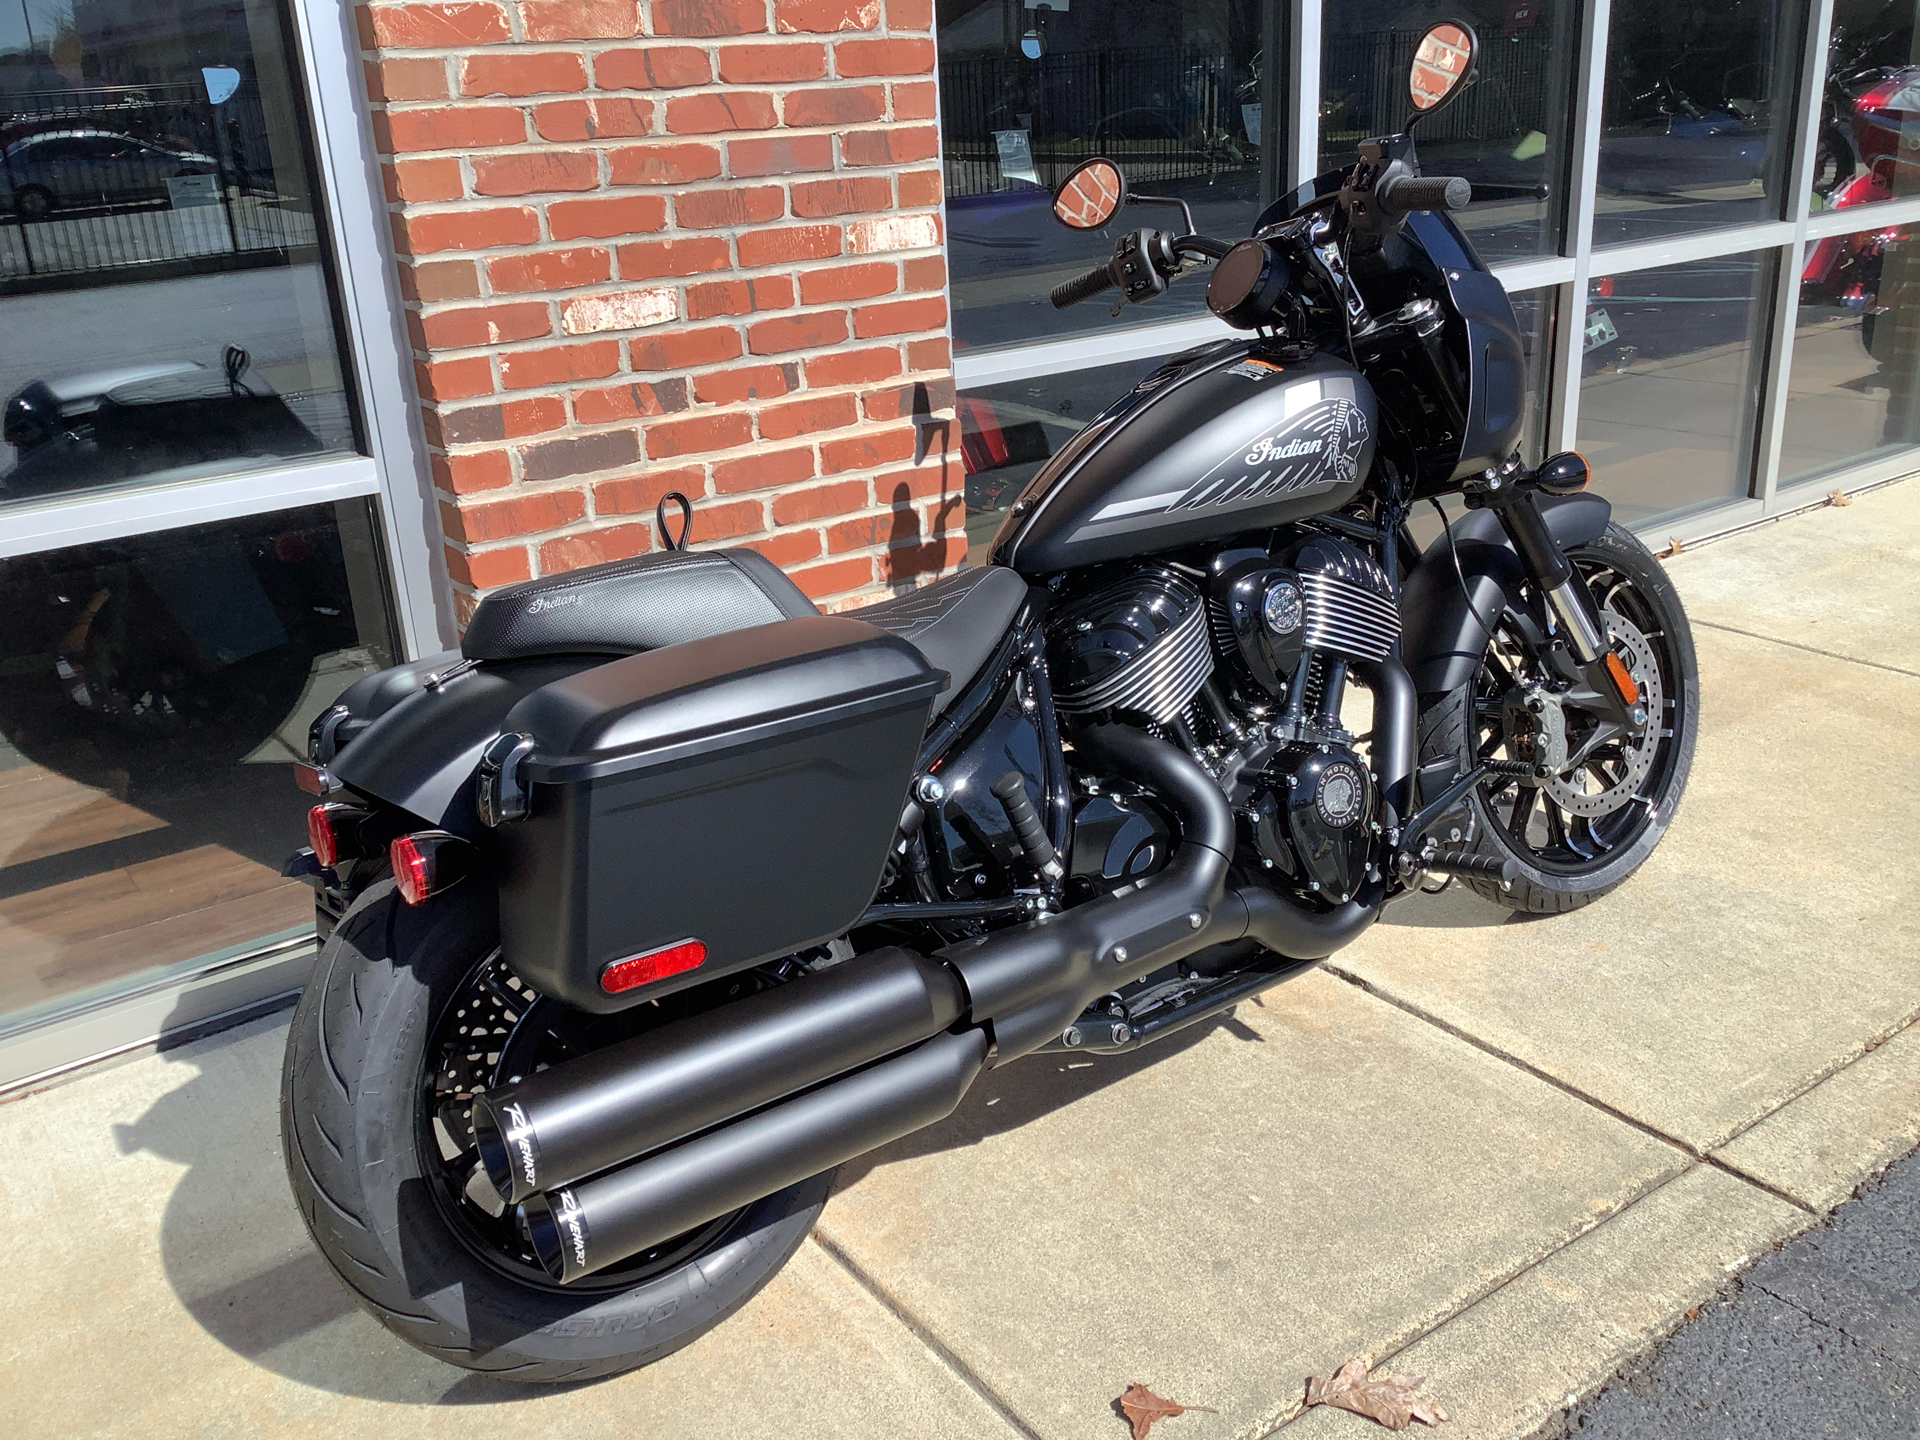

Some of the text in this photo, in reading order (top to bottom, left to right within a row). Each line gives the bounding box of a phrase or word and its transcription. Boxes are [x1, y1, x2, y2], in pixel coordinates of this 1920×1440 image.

[1245, 437, 1322, 465] Indian
[529, 595, 576, 614] Indian
[1318, 766, 1361, 818] INDIAN MOTORCYCLE
